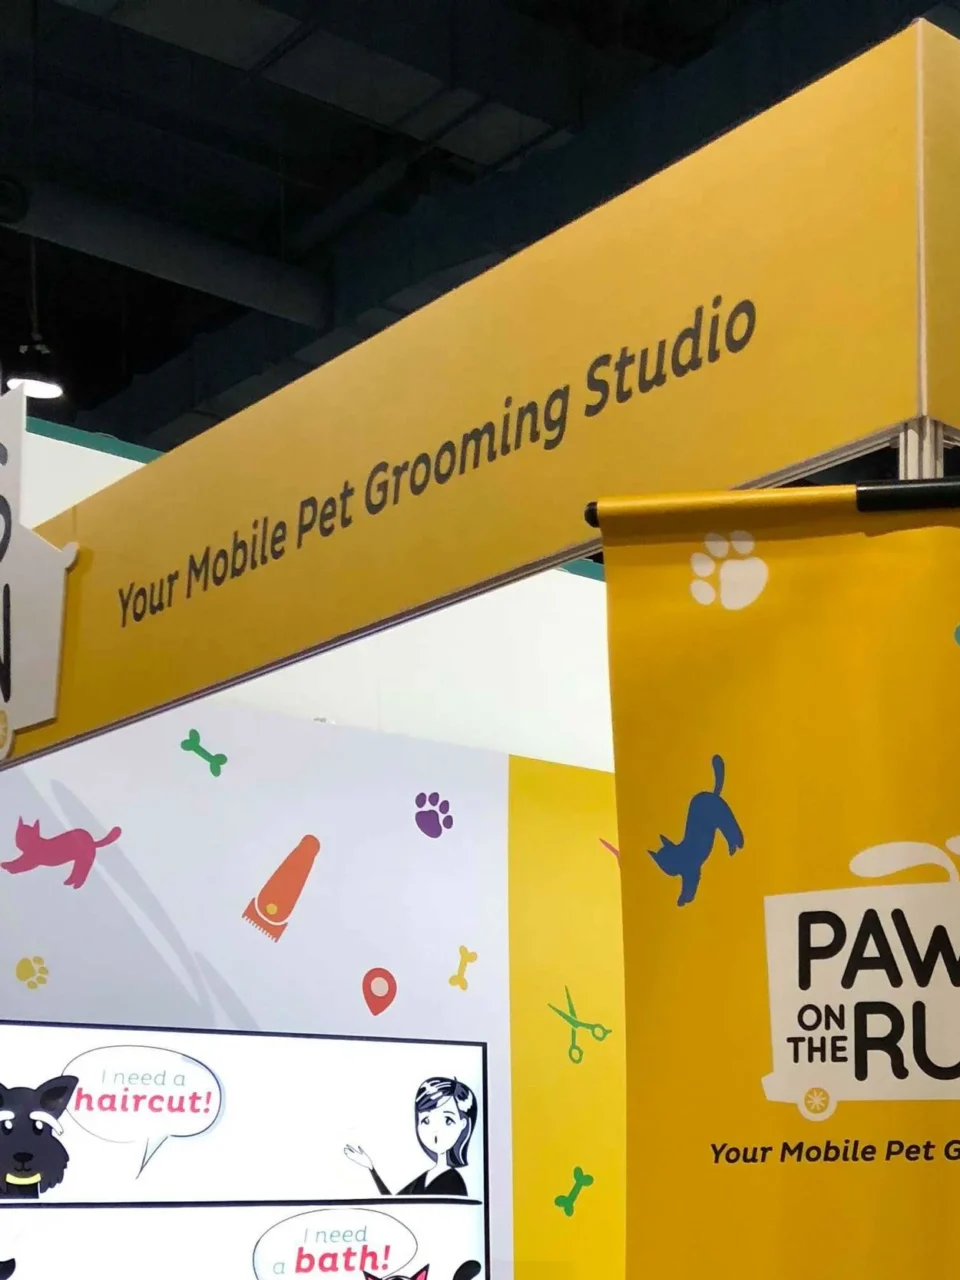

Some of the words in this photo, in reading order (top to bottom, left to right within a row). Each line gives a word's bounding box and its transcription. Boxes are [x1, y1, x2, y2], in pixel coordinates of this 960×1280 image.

[117, 565, 180, 629] Your
[186, 515, 288, 601] Mobile
[296, 479, 355, 550] Pet
[363, 382, 571, 516] Grooming
[583, 293, 758, 419] Studio
[797, 1003, 845, 1031] ON
[786, 1036, 848, 1063] THE
[112, 1068, 167, 1087] need
[173, 1073, 185, 1087] a
[74, 1088, 212, 1114] haircut!
[710, 1143, 773, 1164] Your
[780, 1139, 877, 1163] Mobile
[885, 1139, 936, 1162] Pet
[315, 1225, 368, 1244] need
[272, 1259, 286, 1275] a
[295, 1244, 391, 1275] bath!
